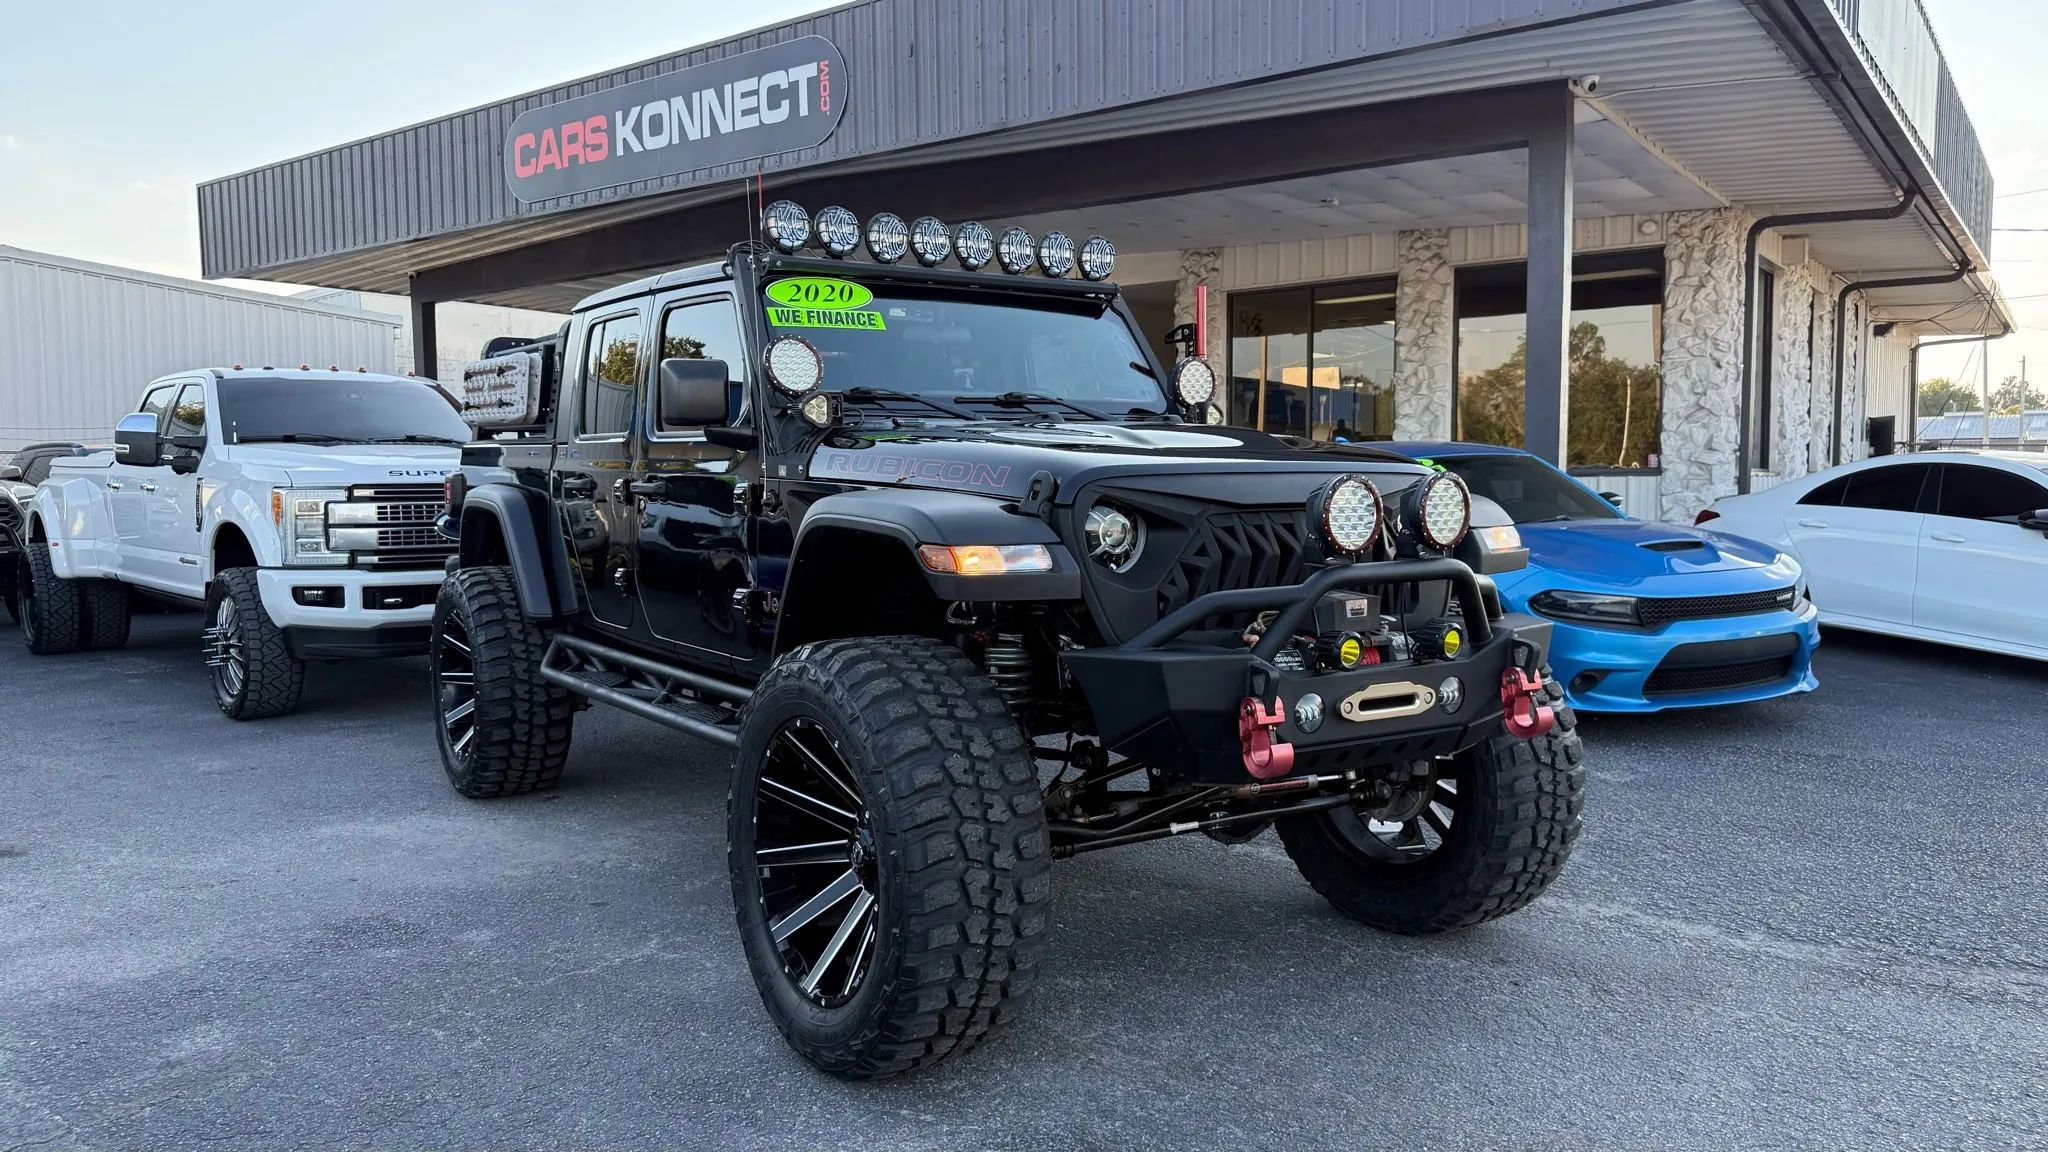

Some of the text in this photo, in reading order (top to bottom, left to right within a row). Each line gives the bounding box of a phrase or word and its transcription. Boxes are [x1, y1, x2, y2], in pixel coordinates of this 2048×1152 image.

[820, 60, 830, 116] .COM
[514, 62, 817, 178] CARS KONNECT
[776, 203, 808, 242] KC
[827, 207, 859, 246] KC
[879, 218, 908, 257] KC
[922, 221, 951, 257] KC
[966, 224, 993, 261] KC
[1010, 231, 1035, 269] KC
[1050, 234, 1075, 270] KC
[1090, 240, 1116, 275] KC
[787, 284, 854, 303] 2020
[775, 309, 878, 327] WE FINANCE
[824, 452, 1012, 487] RUBICON
